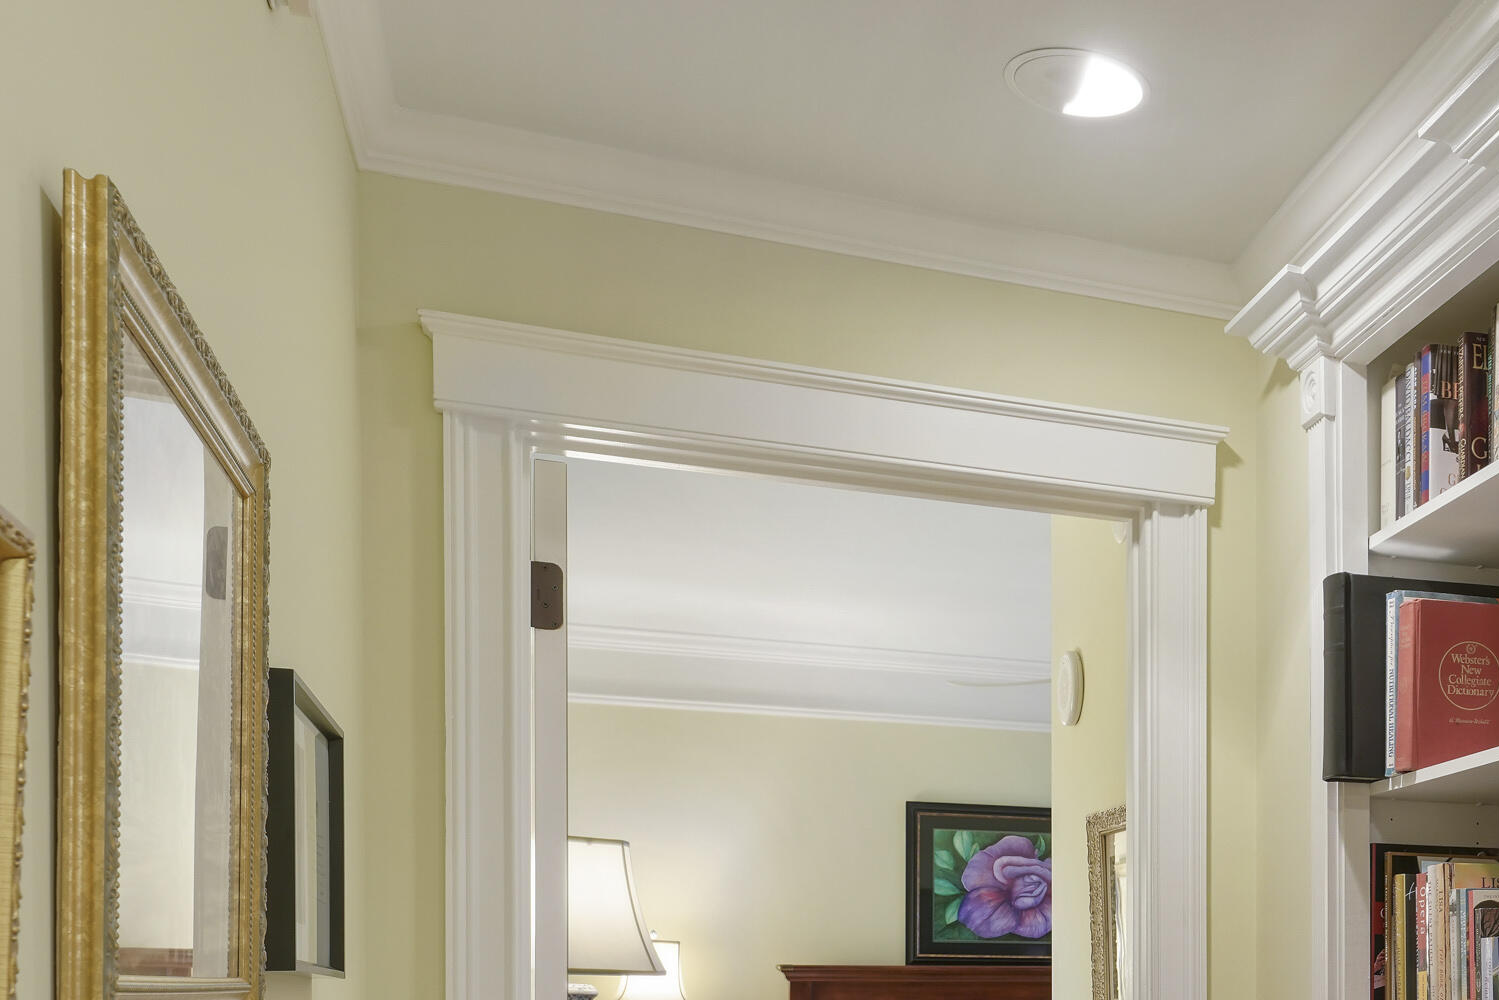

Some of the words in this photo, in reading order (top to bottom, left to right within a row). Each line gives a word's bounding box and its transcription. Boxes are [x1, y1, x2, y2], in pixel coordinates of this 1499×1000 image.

[1451, 653, 1490, 665] Webster's
[1461, 665, 1482, 675] New
[1448, 674, 1493, 687] Collegiate
[1447, 684, 1495, 698] Dictionary
[1418, 887, 1426, 935] Opera
